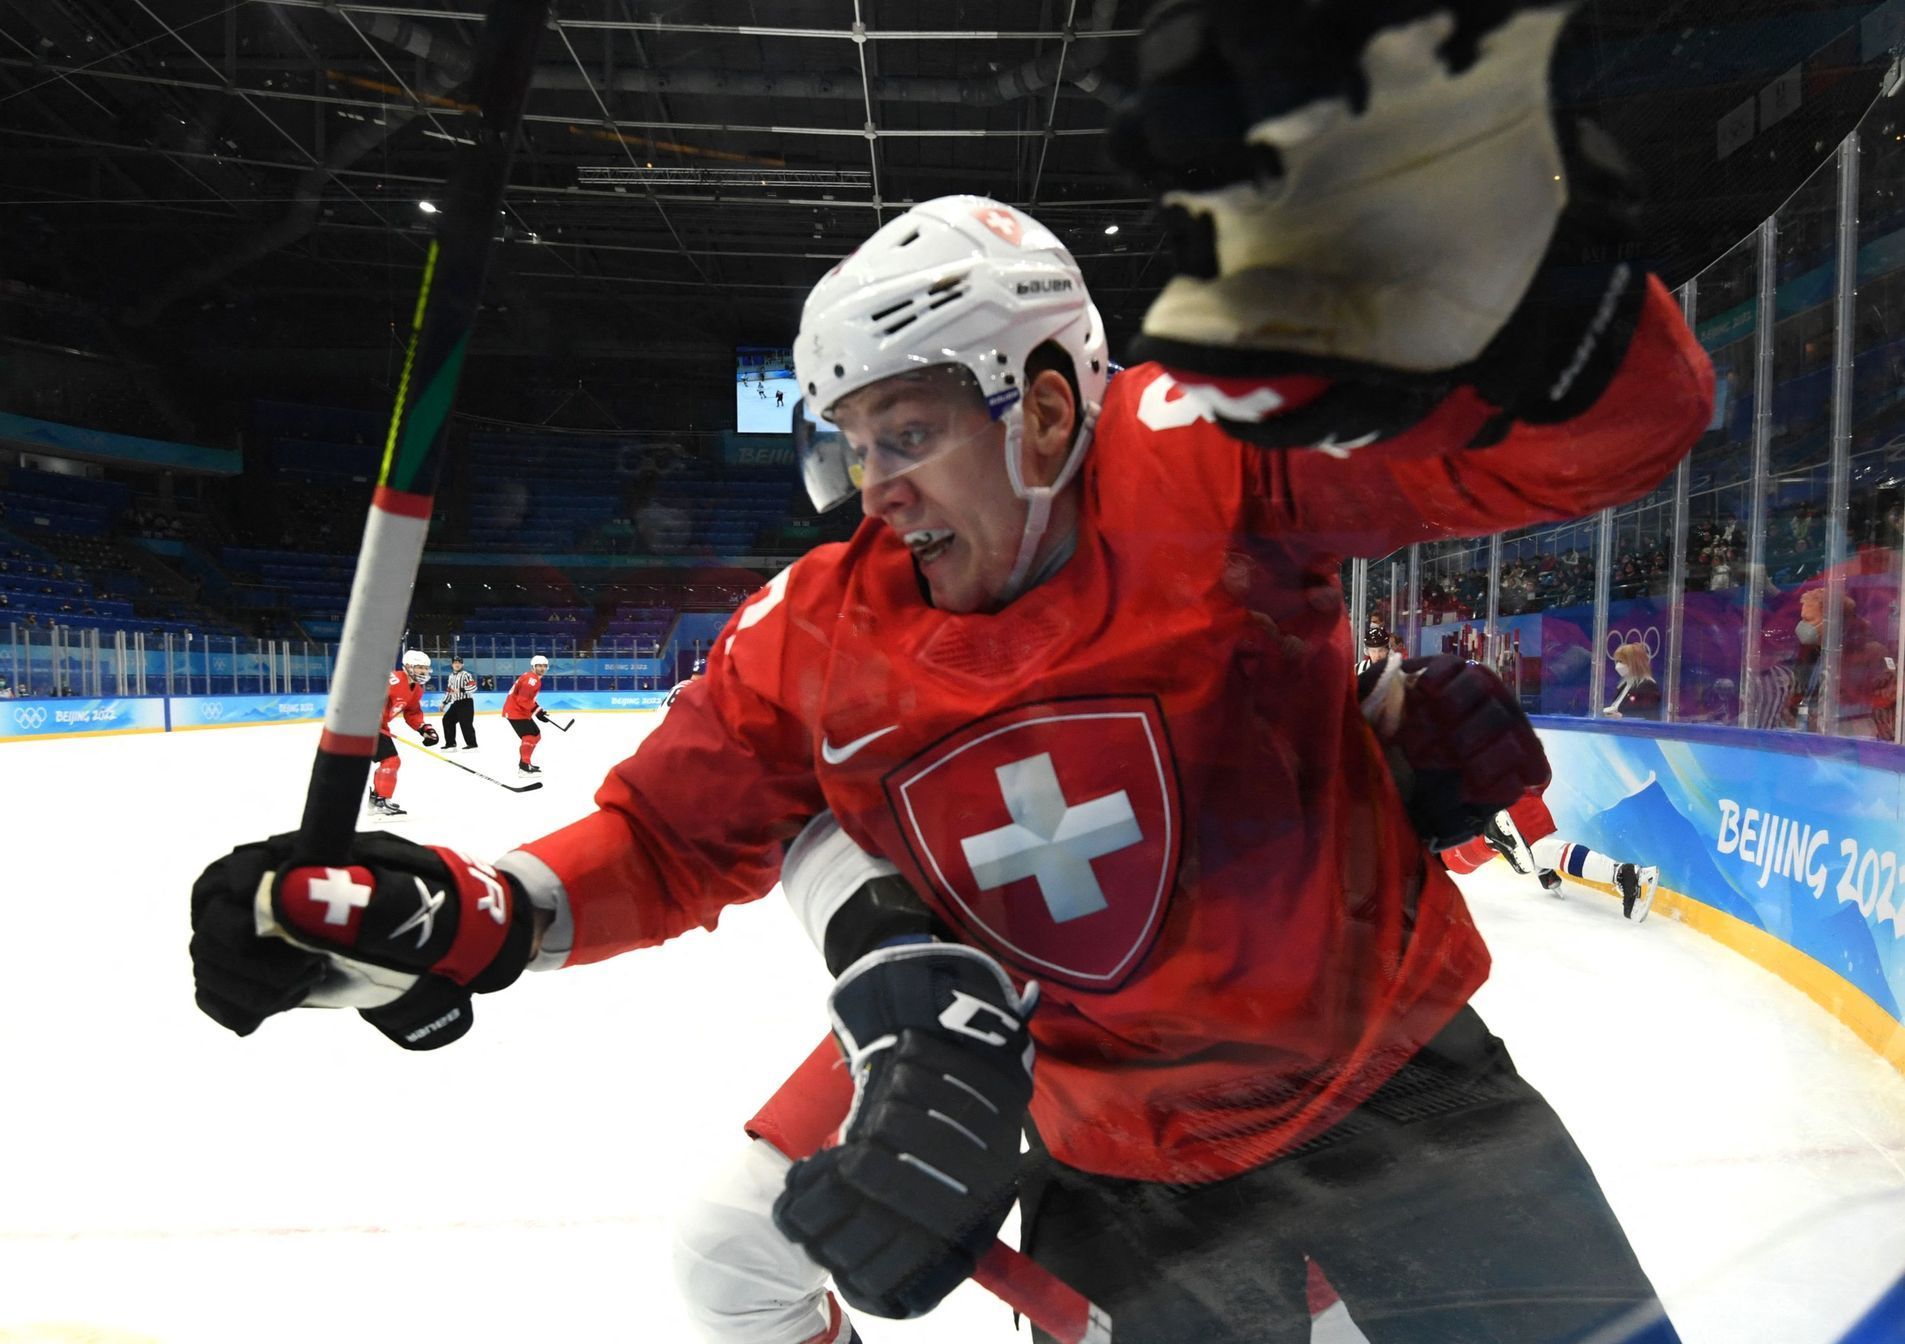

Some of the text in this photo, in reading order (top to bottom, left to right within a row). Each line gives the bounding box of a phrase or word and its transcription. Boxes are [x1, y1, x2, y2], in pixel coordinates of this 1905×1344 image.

[611, 697, 640, 706] BEIJING
[55, 707, 118, 725] BEIJING 2022
[1717, 799, 1830, 900] BEIJING
